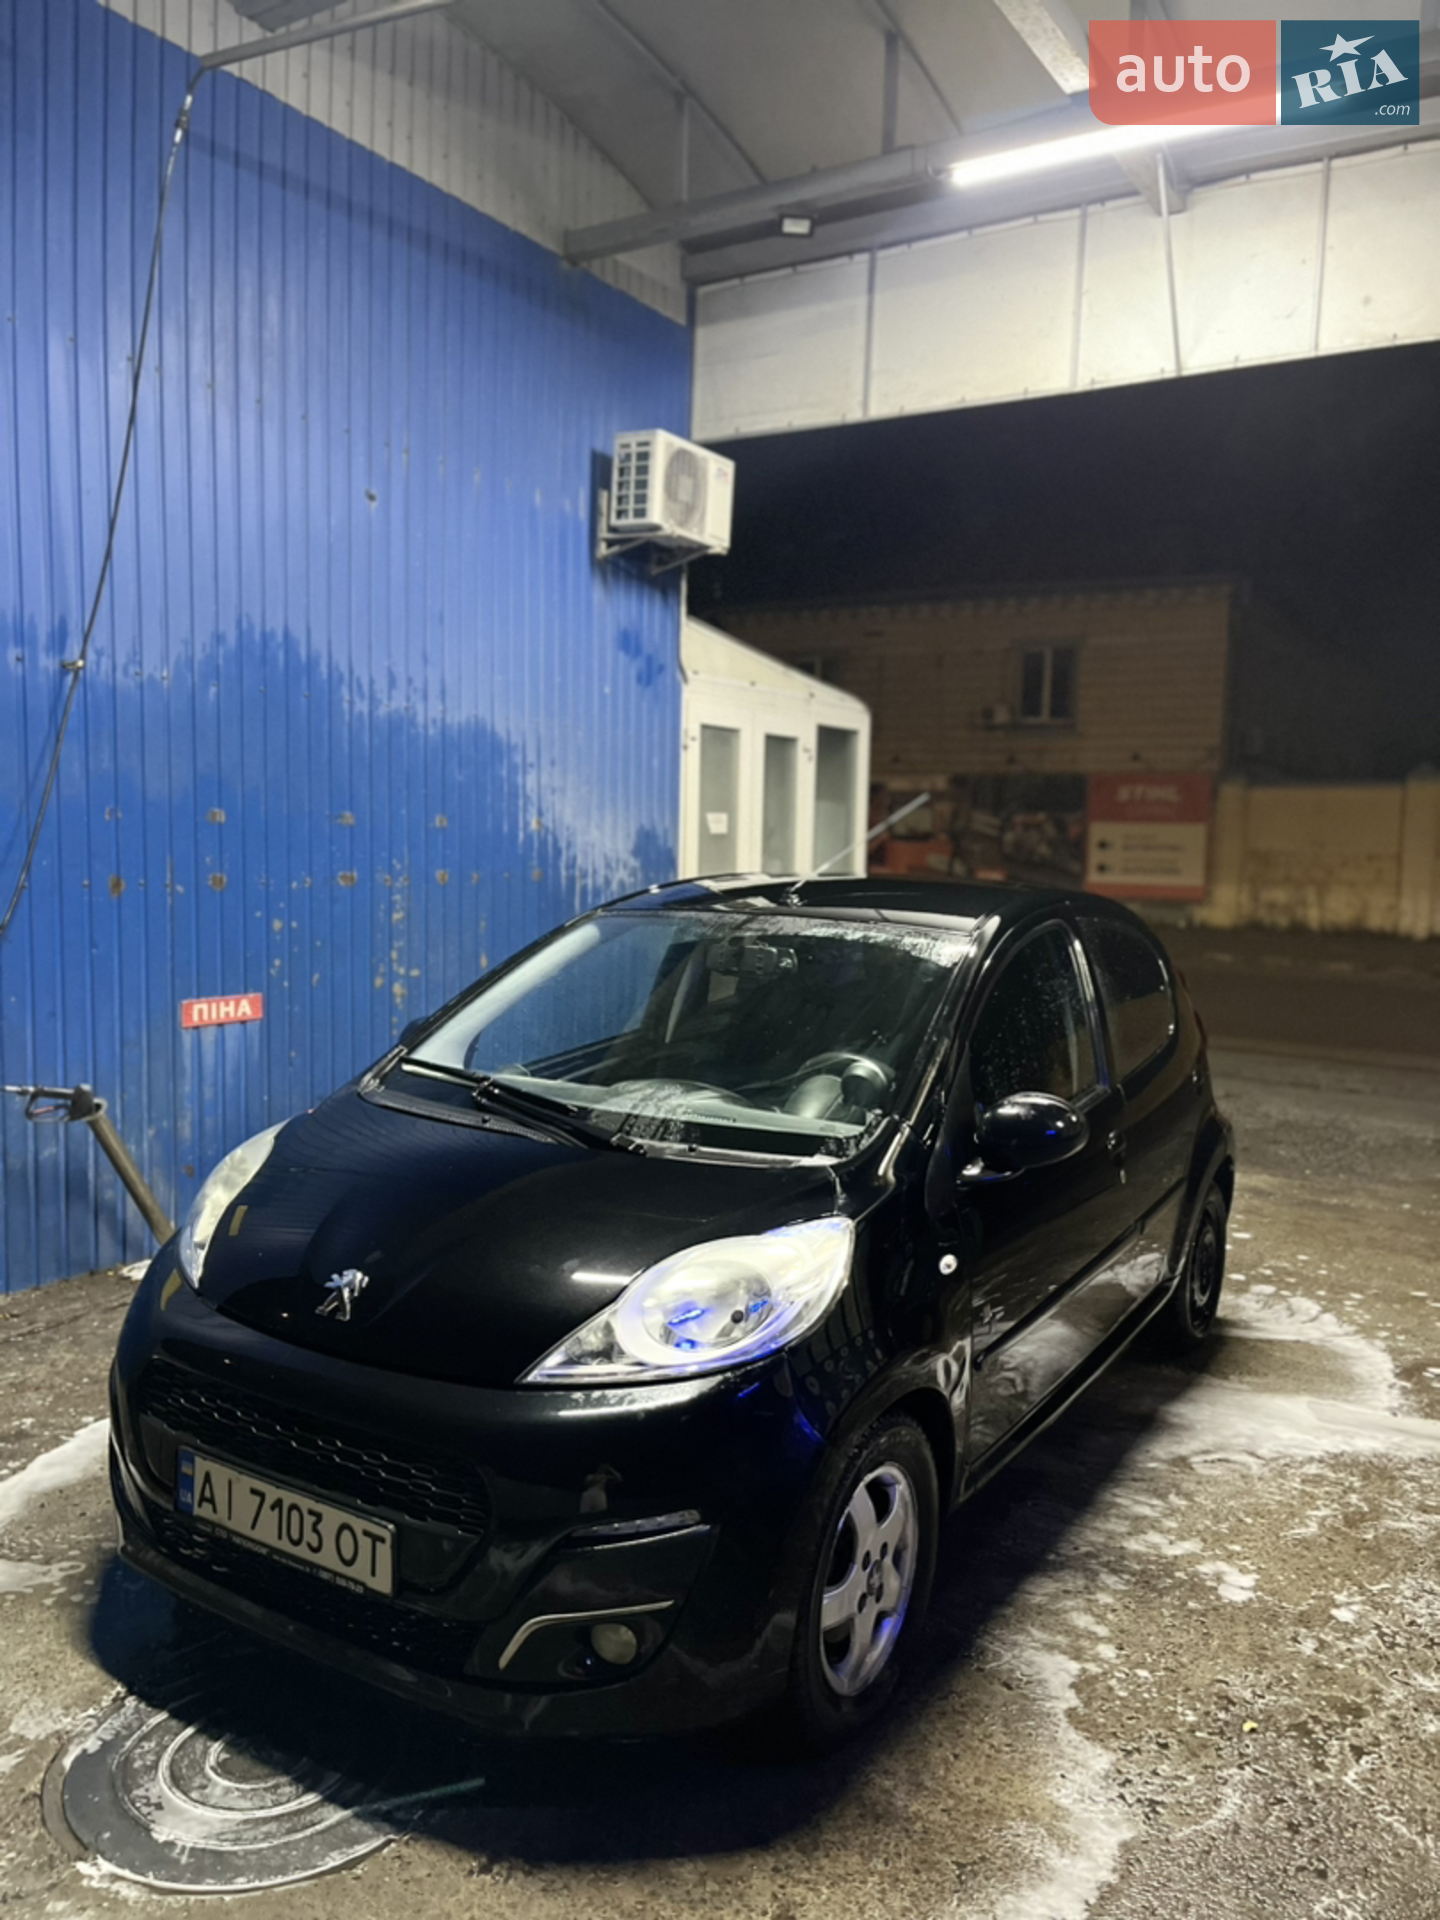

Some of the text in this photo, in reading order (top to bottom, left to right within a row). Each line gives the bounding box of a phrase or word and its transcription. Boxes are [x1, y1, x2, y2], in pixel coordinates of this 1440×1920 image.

[192, 998, 253, 1022] ПІНА
[198, 1470, 233, 1521] AI
[250, 1487, 323, 1554] 7103
[335, 1522, 386, 1577] OT
